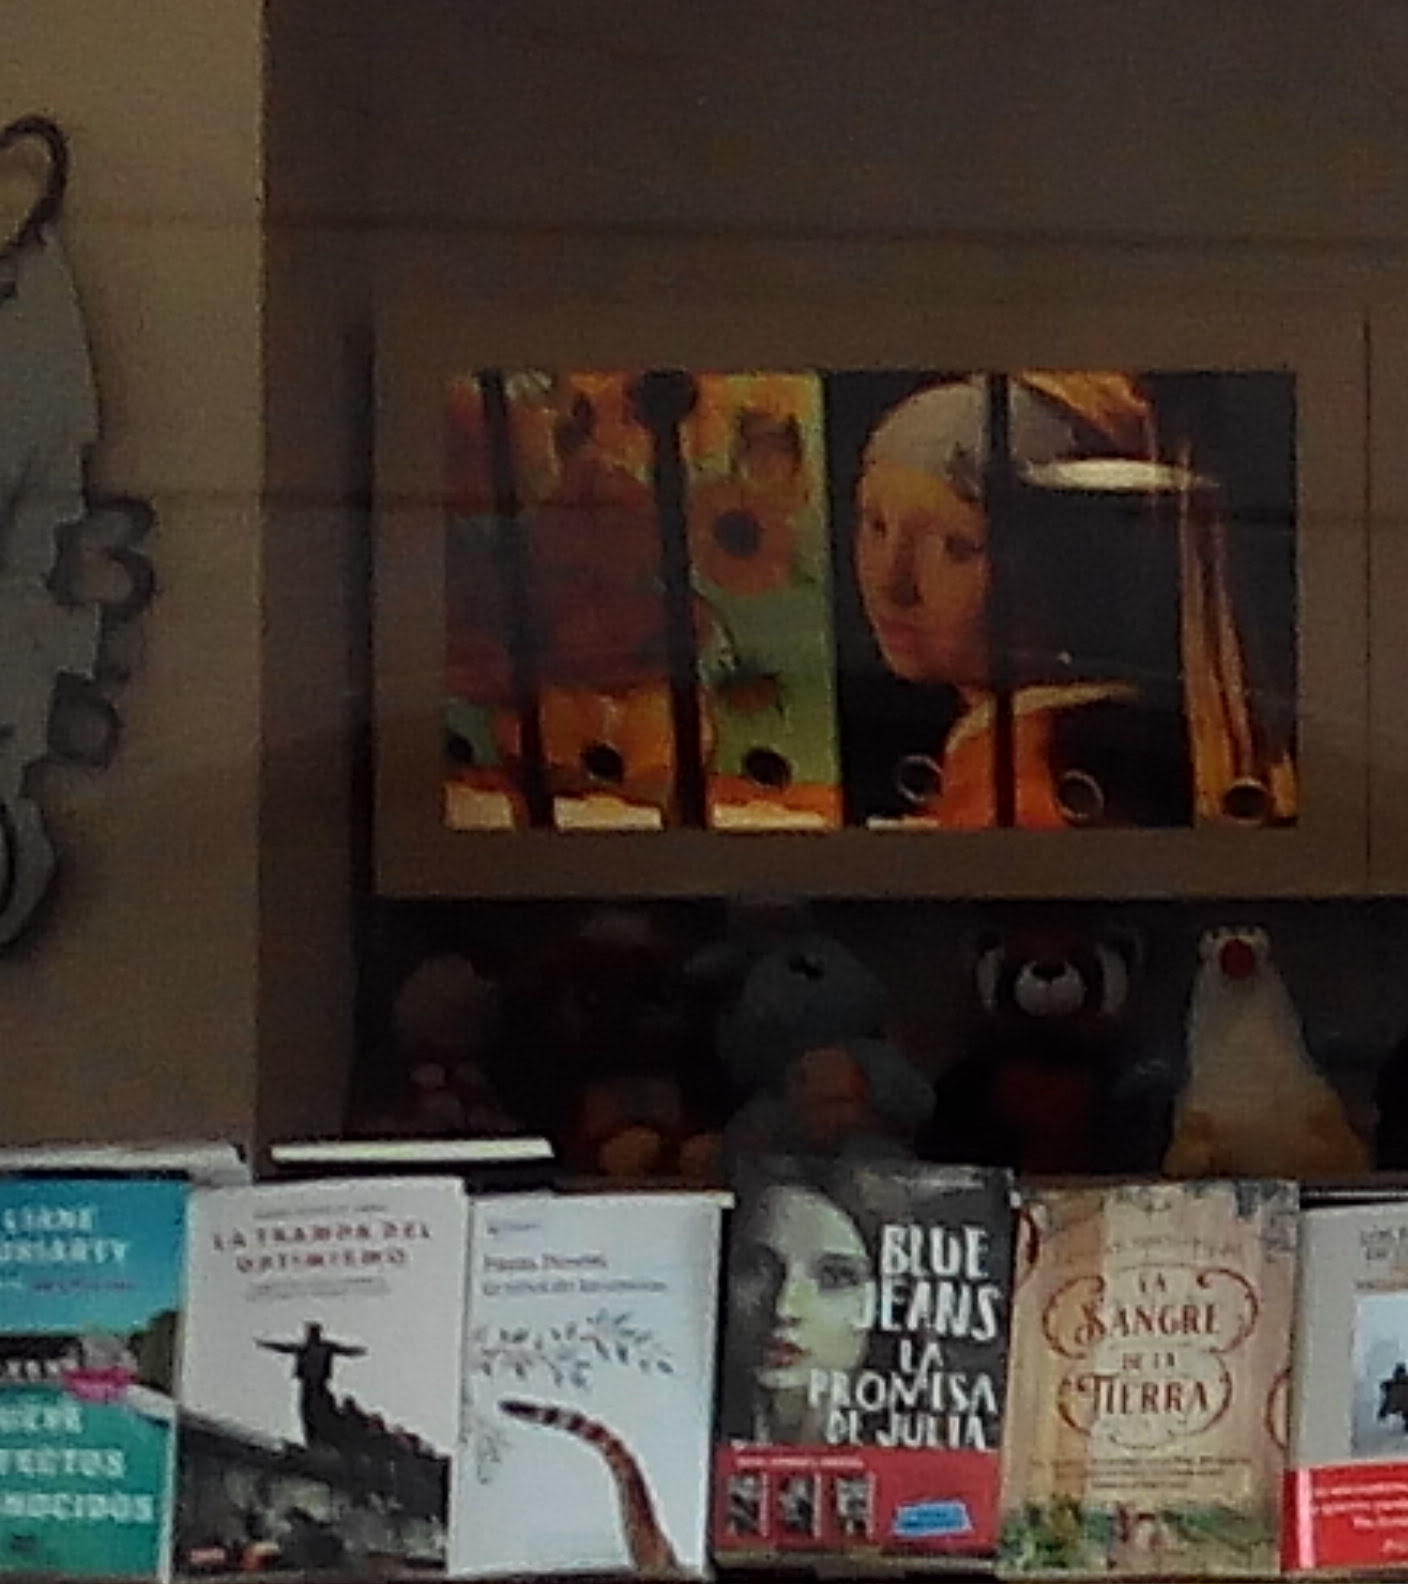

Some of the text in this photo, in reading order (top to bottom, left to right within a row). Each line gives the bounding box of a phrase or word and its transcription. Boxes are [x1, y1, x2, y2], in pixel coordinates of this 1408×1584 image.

[879, 1222, 991, 1281] BLUE
[853, 1279, 1001, 1343] JEANS
[1072, 1299, 1222, 1340] SANGRE
[809, 1368, 999, 1418] PROMISA
[1074, 1373, 1210, 1416] TIERRA
[874, 1411, 990, 1452] JULIA
